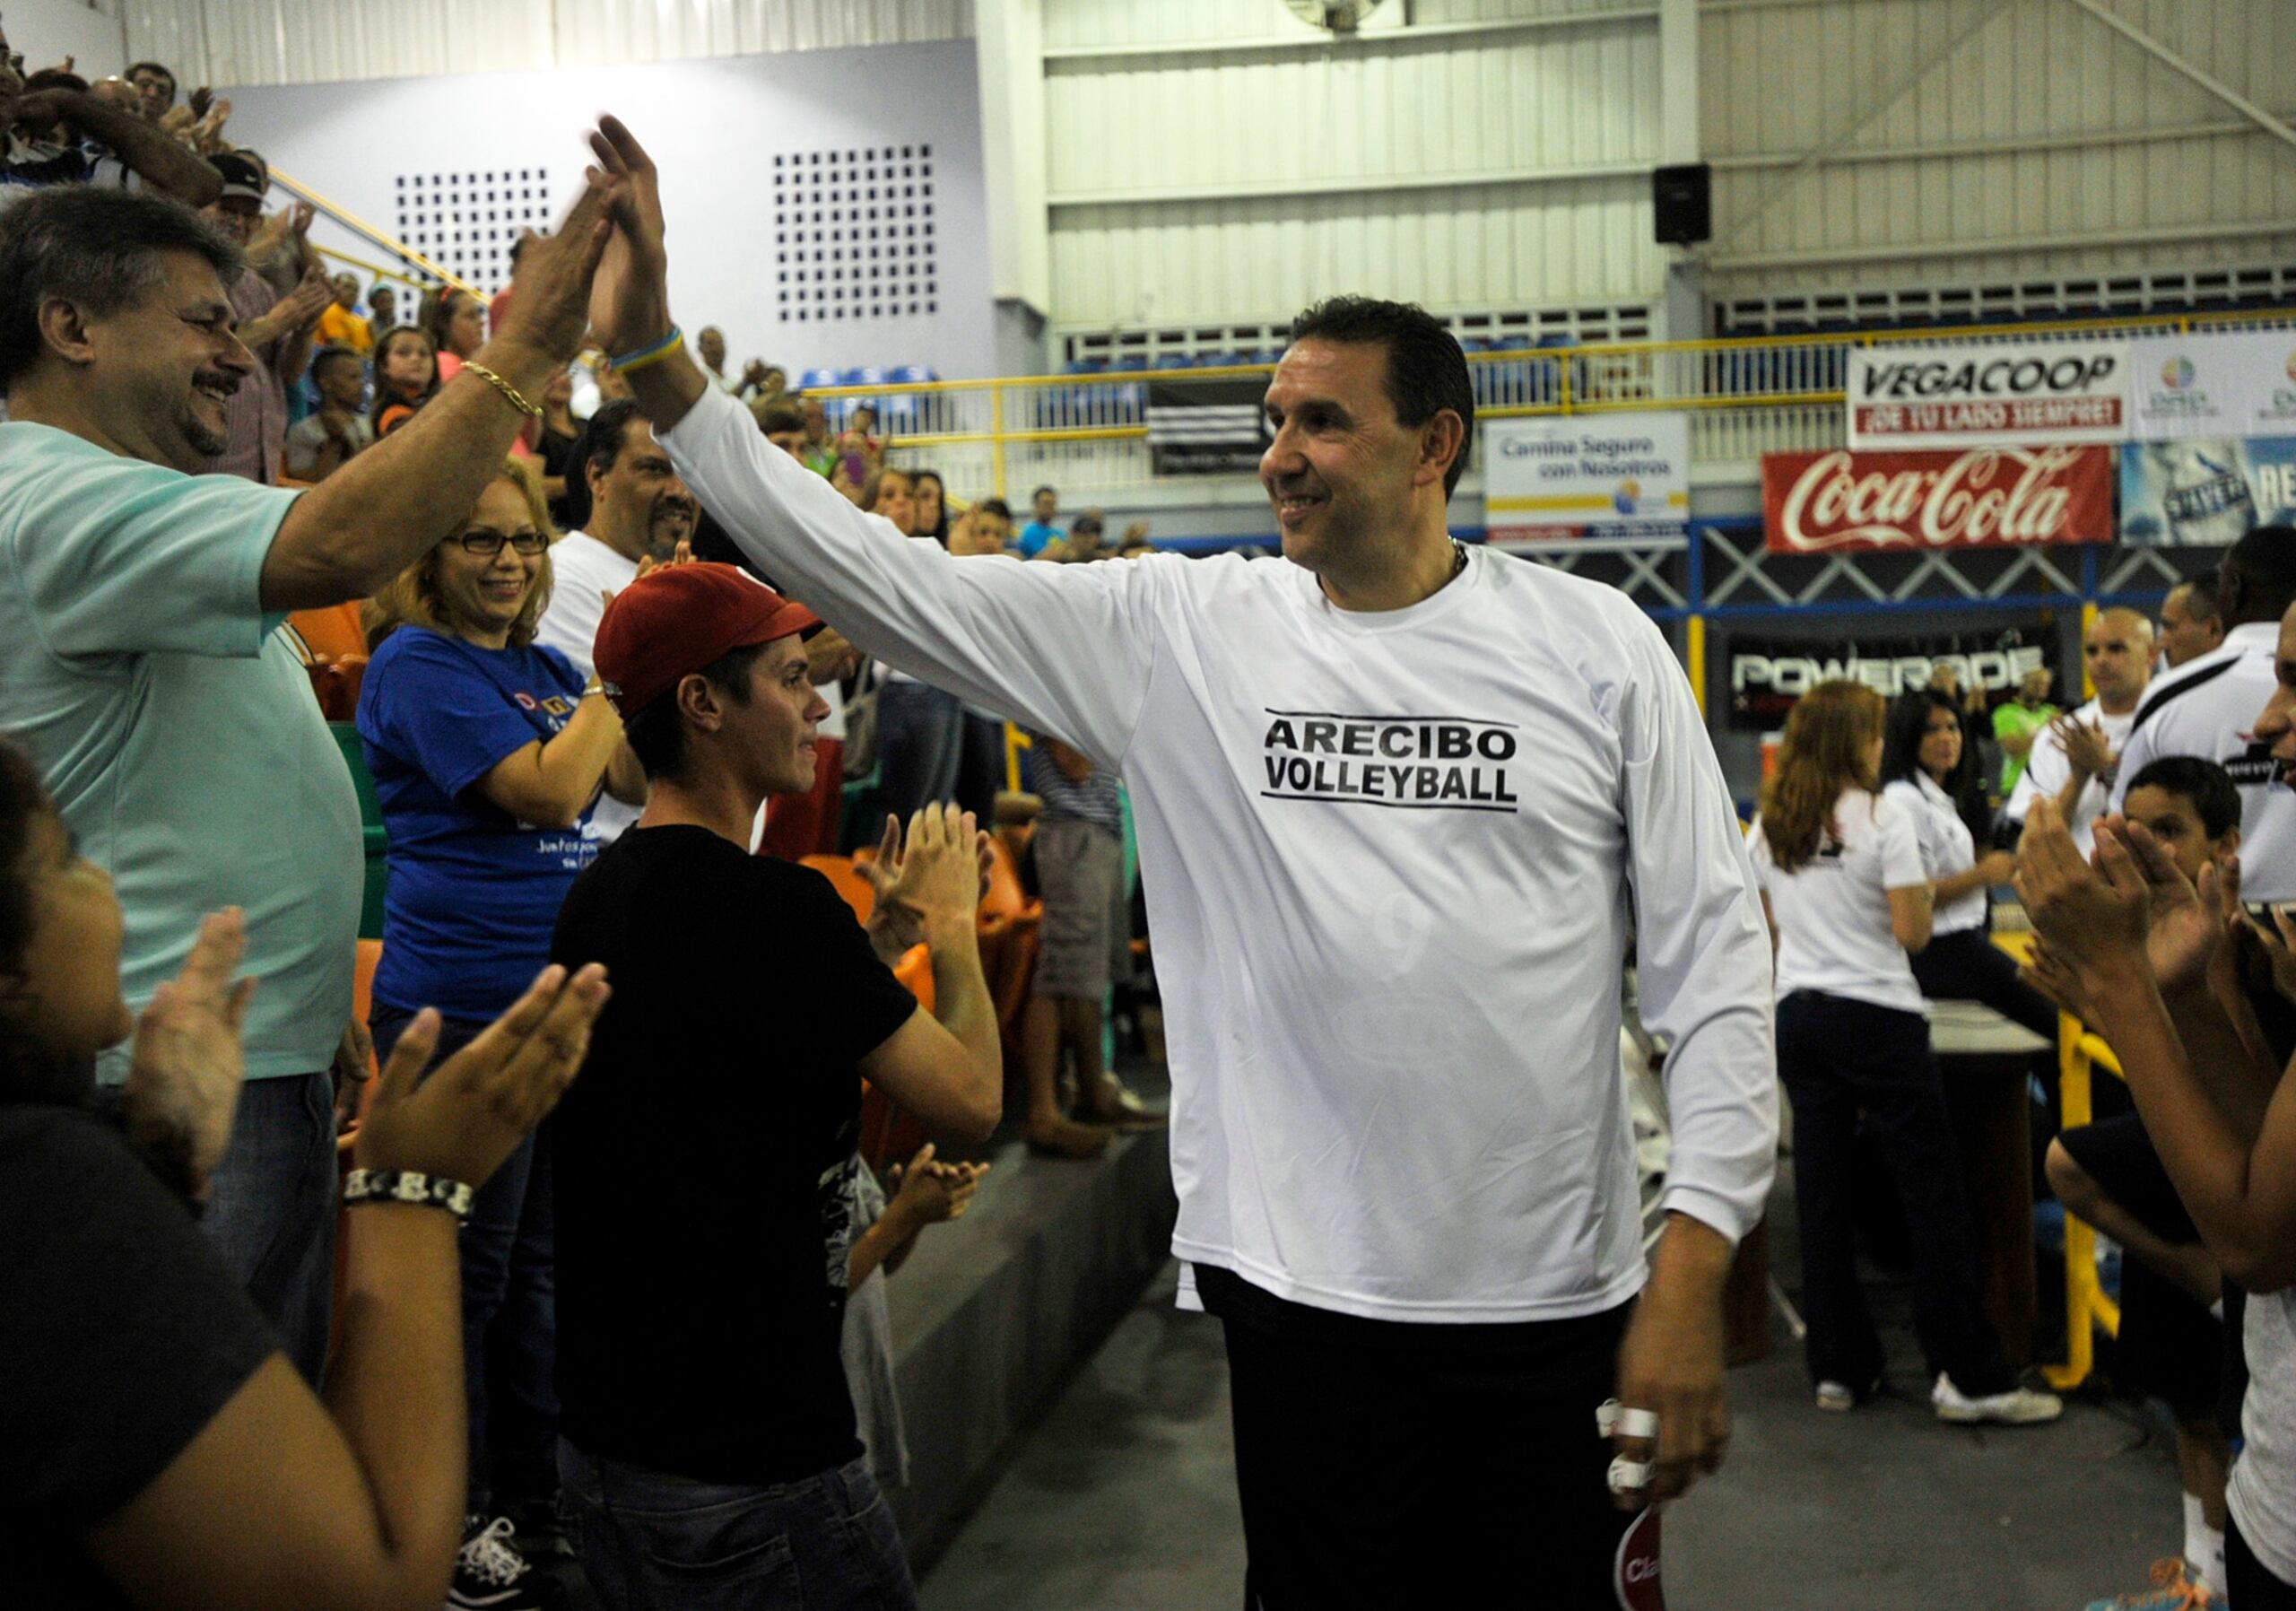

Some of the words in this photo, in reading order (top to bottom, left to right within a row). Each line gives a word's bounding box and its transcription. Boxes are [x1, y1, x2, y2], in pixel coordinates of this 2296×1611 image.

[1863, 355, 2115, 396] VEGACOOP
[1909, 405, 1937, 431] TU
[1944, 402, 2005, 430] LADO
[1500, 437, 1577, 458] Camina
[1539, 463, 1576, 479] con
[1582, 458, 1671, 477] Nosotros
[1731, 646, 2044, 697] POWERADE
[1264, 718, 1517, 761] ARECIBO
[1264, 755, 1518, 802] VOLLEYBALL
